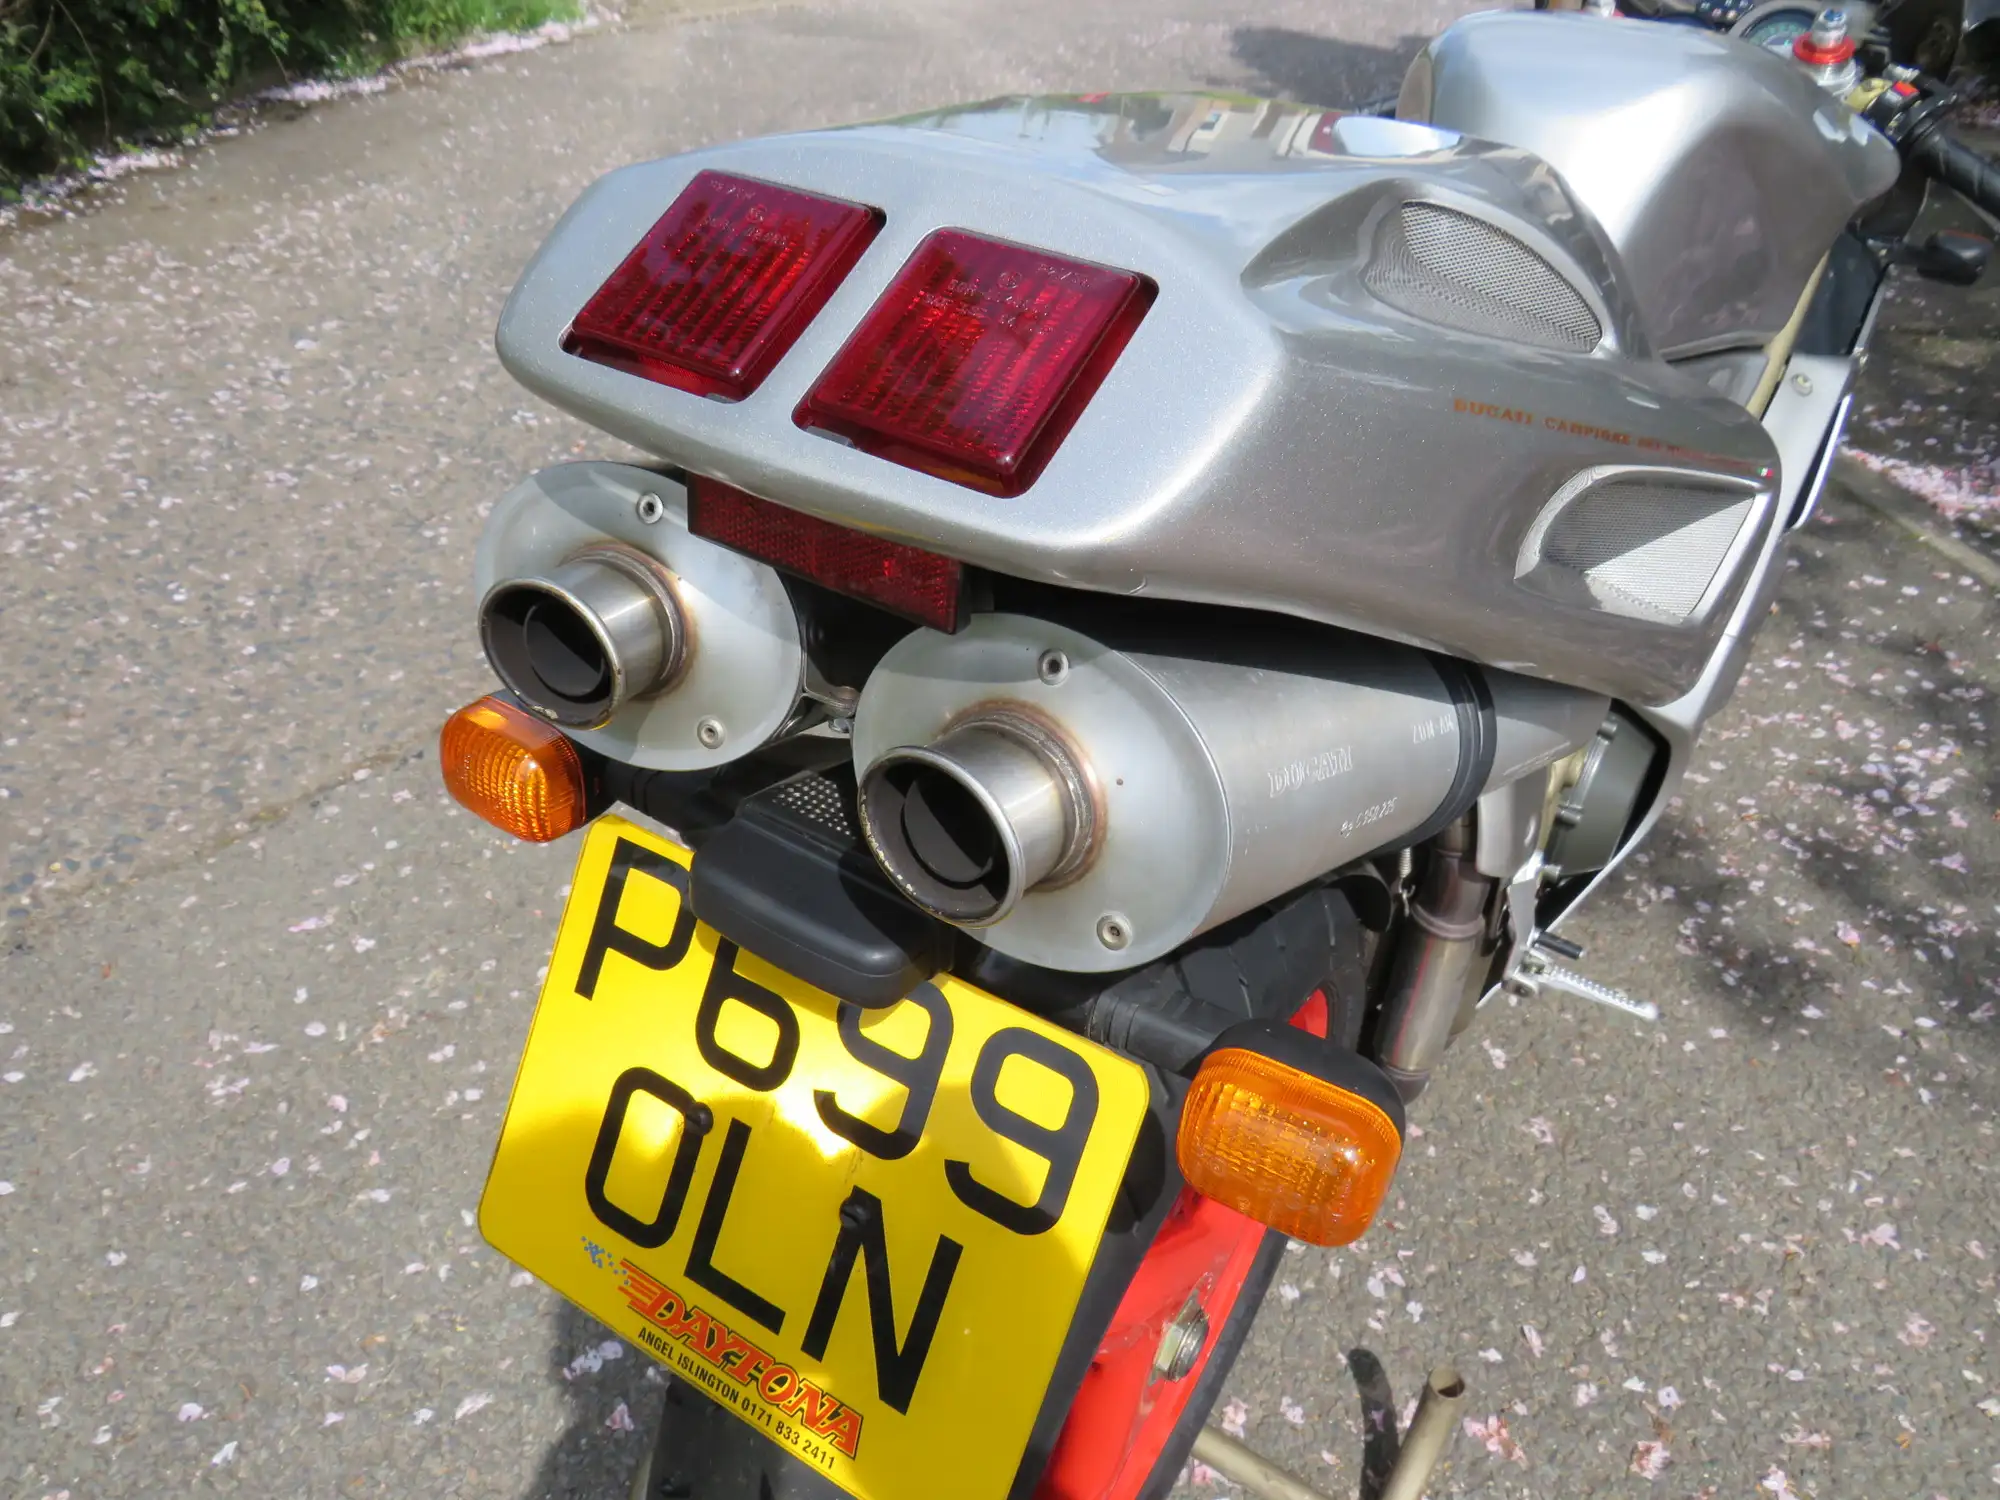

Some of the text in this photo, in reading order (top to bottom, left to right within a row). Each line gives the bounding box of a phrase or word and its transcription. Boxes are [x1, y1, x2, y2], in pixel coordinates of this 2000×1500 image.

[1453, 398, 1533, 426] DUCATI
[575, 836, 1099, 1236] P699
[585, 1066, 963, 1416] OLN
[618, 1258, 863, 1460] DAYTONA
[638, 1327, 836, 1470] ANGEL ISLINGTON 0171 833 2411
